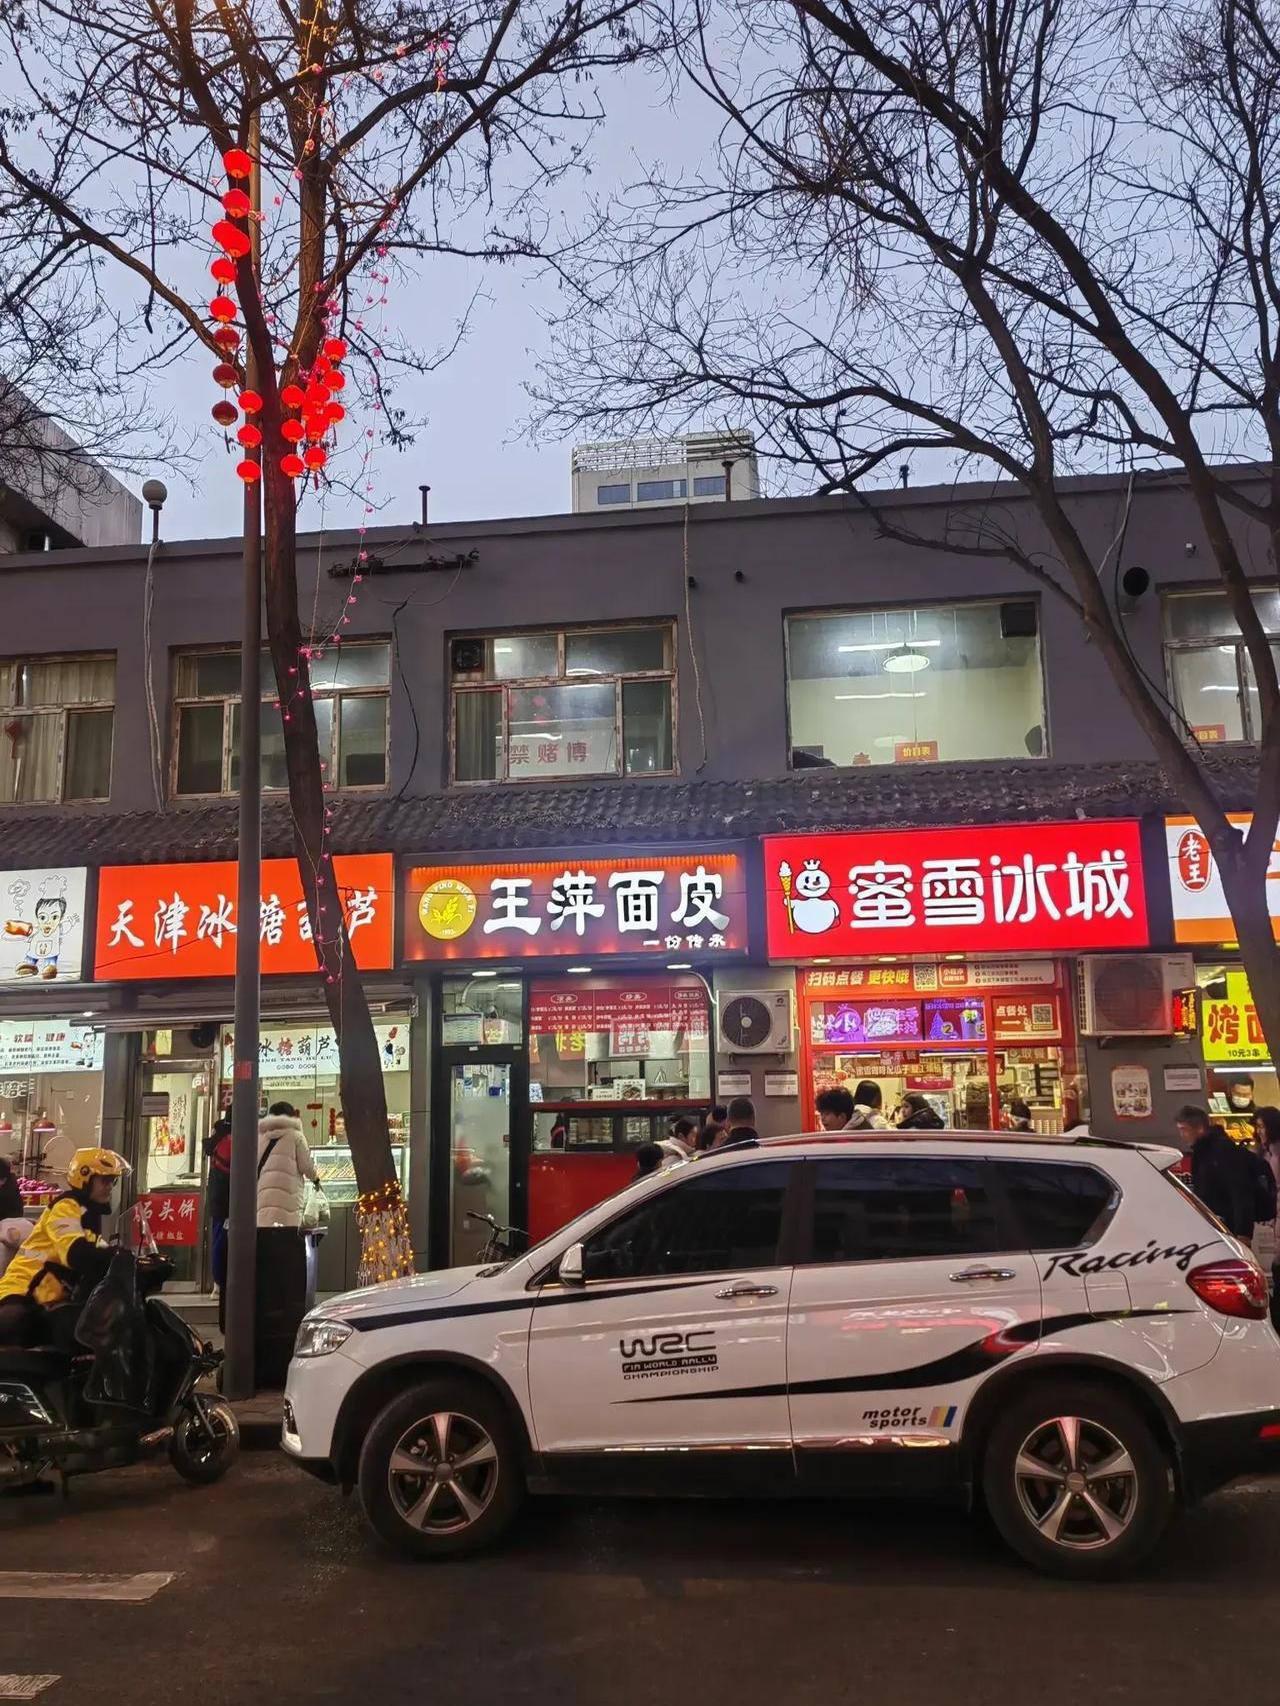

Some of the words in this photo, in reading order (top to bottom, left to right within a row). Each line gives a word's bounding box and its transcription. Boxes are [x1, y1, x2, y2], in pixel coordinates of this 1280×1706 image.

[1182, 833, 1205, 884] 老王
[848, 849, 1134, 929] 蜜雪冰城
[483, 865, 730, 936] 王萍面皮
[643, 934, 726, 950] 一份传承
[808, 970, 864, 987] 扫码点餐
[996, 1004, 1028, 1017] 点餐处
[258, 1035, 331, 1057] 冰糖葫芦
[1043, 1240, 1224, 1281] Racing
[644, 1360, 677, 1369] WORLD
[682, 1355, 716, 1365] RALLY
[624, 1366, 719, 1380] CHAMPIONSHIP
[862, 1406, 922, 1420] motor
[869, 1417, 927, 1430] sports
